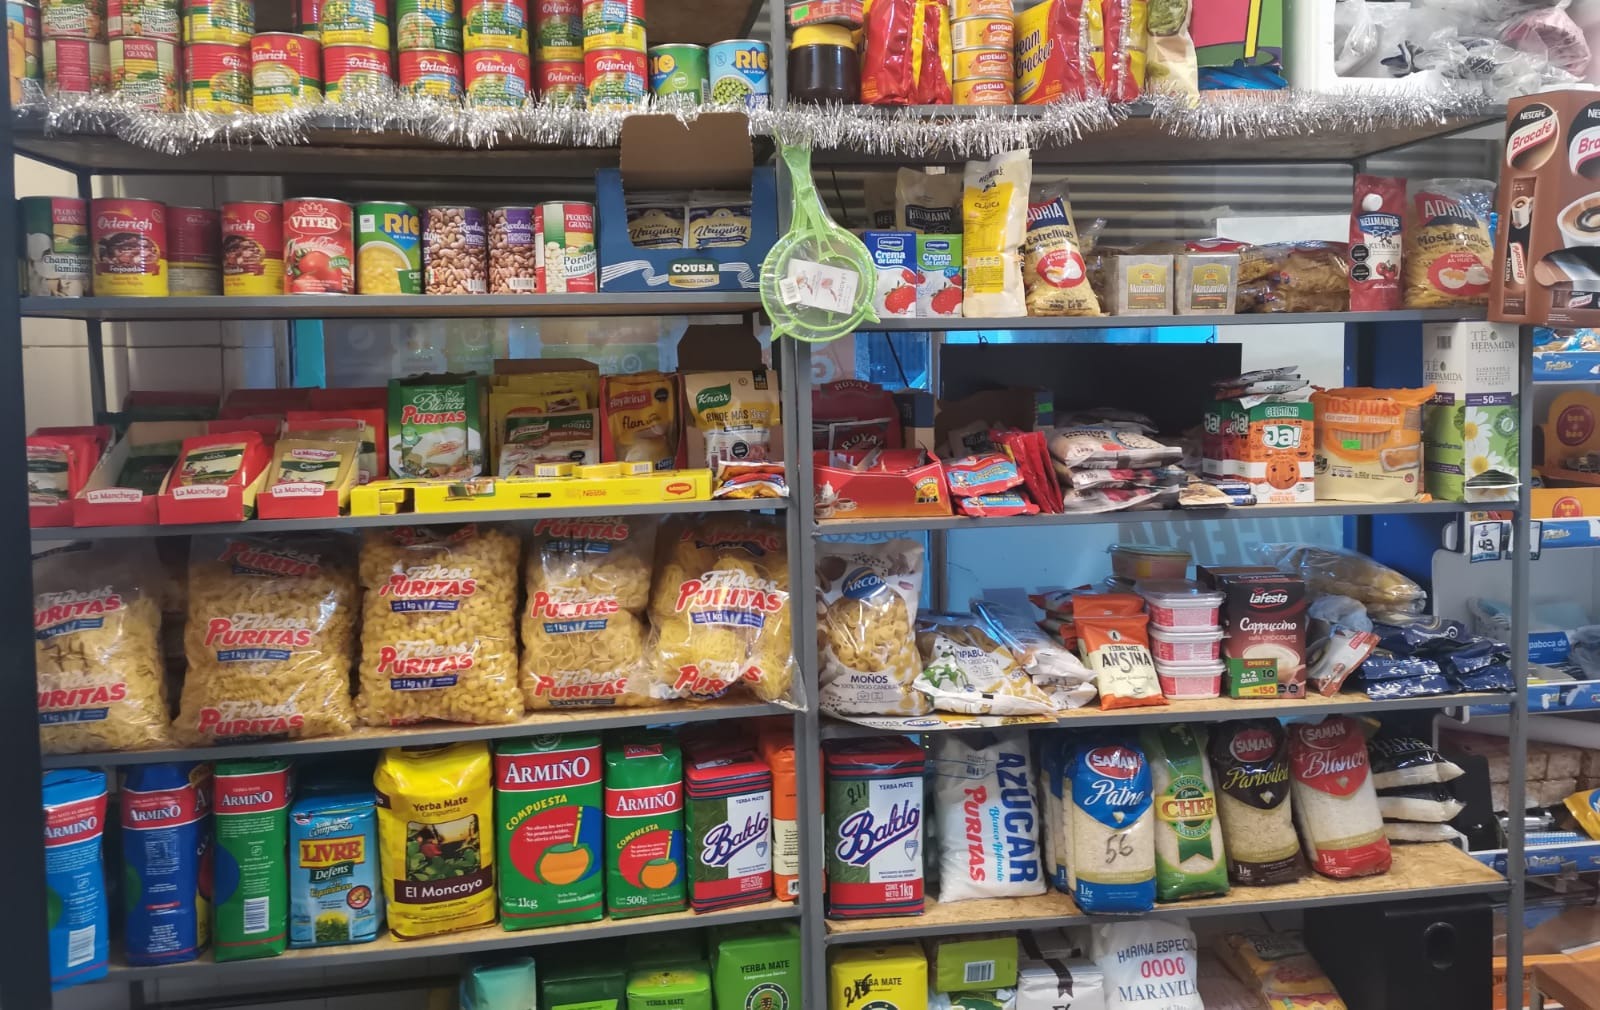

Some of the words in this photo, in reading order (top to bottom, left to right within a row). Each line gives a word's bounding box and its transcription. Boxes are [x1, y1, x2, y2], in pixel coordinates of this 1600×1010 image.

[1014, 29, 1041, 56] ream
[475, 60, 516, 74] Oderich
[596, 60, 635, 72] Oderich
[736, 49, 770, 70] RIO
[1520, 108, 1547, 121] NESCAFÉ
[1511, 120, 1553, 151] Bracafé
[1027, 201, 1064, 223] ADRIA
[97, 216, 153, 232] Oderich
[291, 216, 339, 231] VITER
[384, 213, 420, 234] RIO
[629, 225, 681, 239] Uruguay
[694, 224, 748, 238] Uruguay
[875, 250, 906, 260] Crema
[886, 257, 904, 265] Leche
[923, 253, 952, 262] Crema
[933, 258, 950, 266] Leche
[672, 263, 715, 273] COUSA
[1471, 340, 1517, 351] HEPAMIDA
[834, 381, 871, 392] ROYAL
[698, 392, 730, 405] Knorr
[1483, 396, 1496, 405] 50
[401, 405, 467, 425] PURITAS
[705, 411, 730, 423] RINDE
[1265, 405, 1299, 417] GELATINA
[1324, 400, 1402, 418] TOSTADAS
[622, 415, 645, 429] flan
[100, 493, 140, 502] Manchega
[185, 487, 226, 497] Manchega
[273, 487, 283, 495] La
[284, 486, 323, 495] Manchega
[405, 564, 473, 581] Fideos
[702, 569, 778, 594] Fideos
[378, 572, 478, 597] PURITAS
[674, 578, 784, 613] PURITAS
[33, 594, 123, 628] URITAS
[203, 618, 313, 648] PURITAS
[1239, 616, 1298, 635] Cappuccino
[396, 639, 469, 656] Fideos
[376, 645, 475, 676] PURITAS
[1101, 650, 1153, 674] ANSINA
[534, 676, 629, 698] PURITAS
[673, 664, 763, 692] PURS
[850, 674, 889, 685] MOÑOS
[37, 682, 127, 709] URITAS
[197, 707, 306, 738] PURITAS
[1304, 723, 1346, 741] SAMAN
[1234, 736, 1274, 755] SAMAN
[504, 755, 591, 785] ARMIÑO
[1092, 750, 1139, 771] SAMAN
[1302, 750, 1367, 780] Blanco
[879, 783, 898, 792] YERBA
[898, 781, 914, 790] MATE
[1083, 779, 1146, 808] Patna
[223, 790, 274, 808] ARMIÑO
[413, 802, 442, 816] Yerba
[443, 796, 469, 808] Mate
[615, 790, 677, 813] ARMIÑO
[1161, 797, 1214, 818] CHEF
[130, 802, 183, 823] ARMIÑO
[505, 793, 568, 831] COMPUESTA
[995, 751, 1039, 884] AZUCAR
[45, 815, 98, 839] ARMIÑO
[615, 823, 660, 850] COMPUESTA
[837, 800, 922, 866] Baldo
[963, 785, 989, 883] PURITAS
[702, 811, 770, 866] Baldo
[300, 839, 364, 863] LIVRE
[1104, 833, 1136, 866] 56
[313, 864, 350, 882] Defens
[404, 886, 418, 899] El
[421, 878, 483, 900] Moncayo
[517, 895, 540, 909] 1kg
[626, 894, 648, 907] 500g
[1117, 944, 1155, 964] HARINA
[740, 961, 768, 974] YERBA
[768, 959, 791, 971] MATE
[1140, 956, 1187, 979] 0000
[881, 977, 903, 987] MATE
